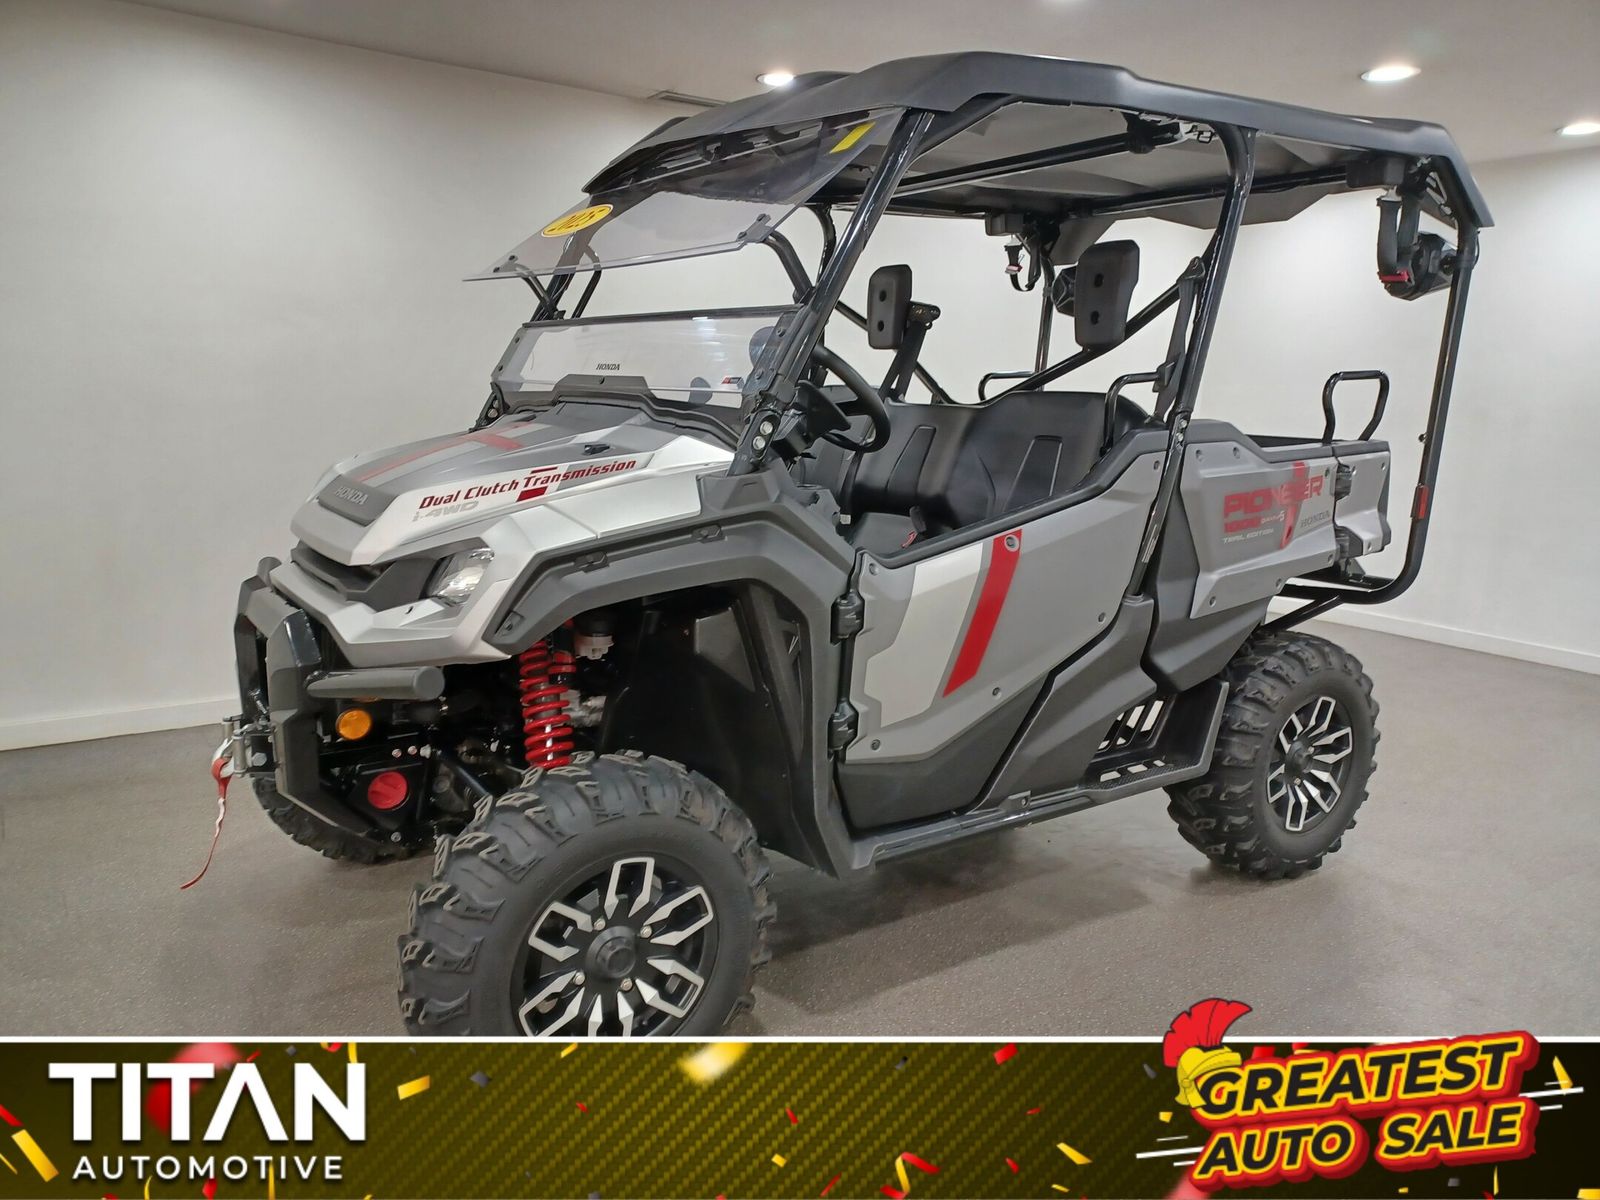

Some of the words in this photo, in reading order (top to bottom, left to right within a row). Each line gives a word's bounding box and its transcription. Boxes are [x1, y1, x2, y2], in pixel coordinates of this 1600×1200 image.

[595, 363, 621, 371] HONDA
[418, 490, 461, 510] Dual
[463, 479, 520, 501] Clutch
[523, 459, 637, 489] Transmission
[334, 486, 369, 505] HONDA
[1223, 475, 1324, 518] PIONEER
[1300, 510, 1331, 528] HONDA
